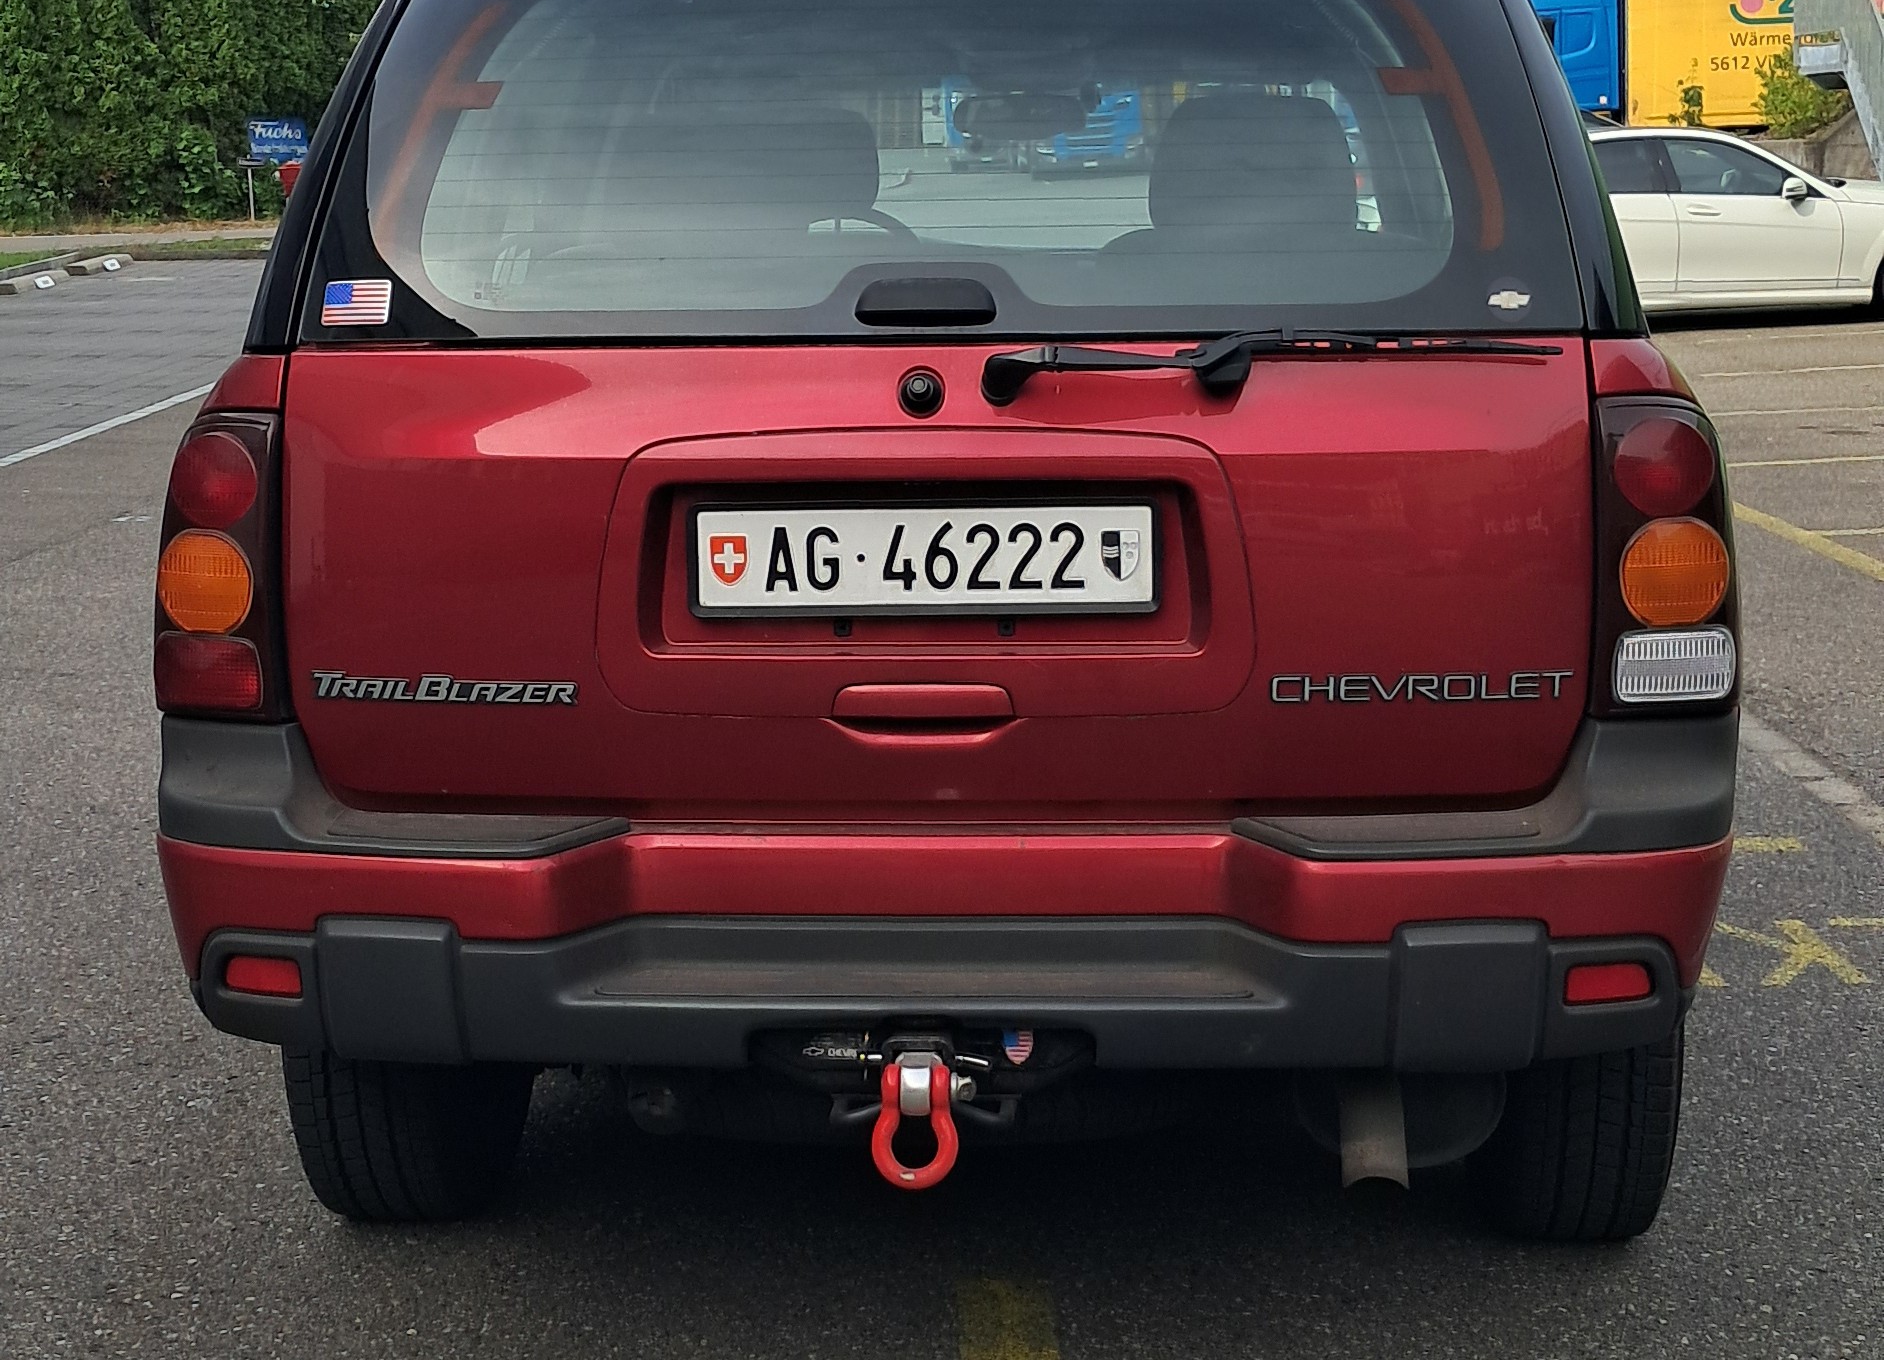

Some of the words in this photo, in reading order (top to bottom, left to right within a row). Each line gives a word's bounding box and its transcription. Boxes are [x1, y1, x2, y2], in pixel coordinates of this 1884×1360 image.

[1710, 56, 1750, 72] 5612
[248, 121, 302, 140] Fuchs
[1270, 669, 1575, 703] CHEVROLET
